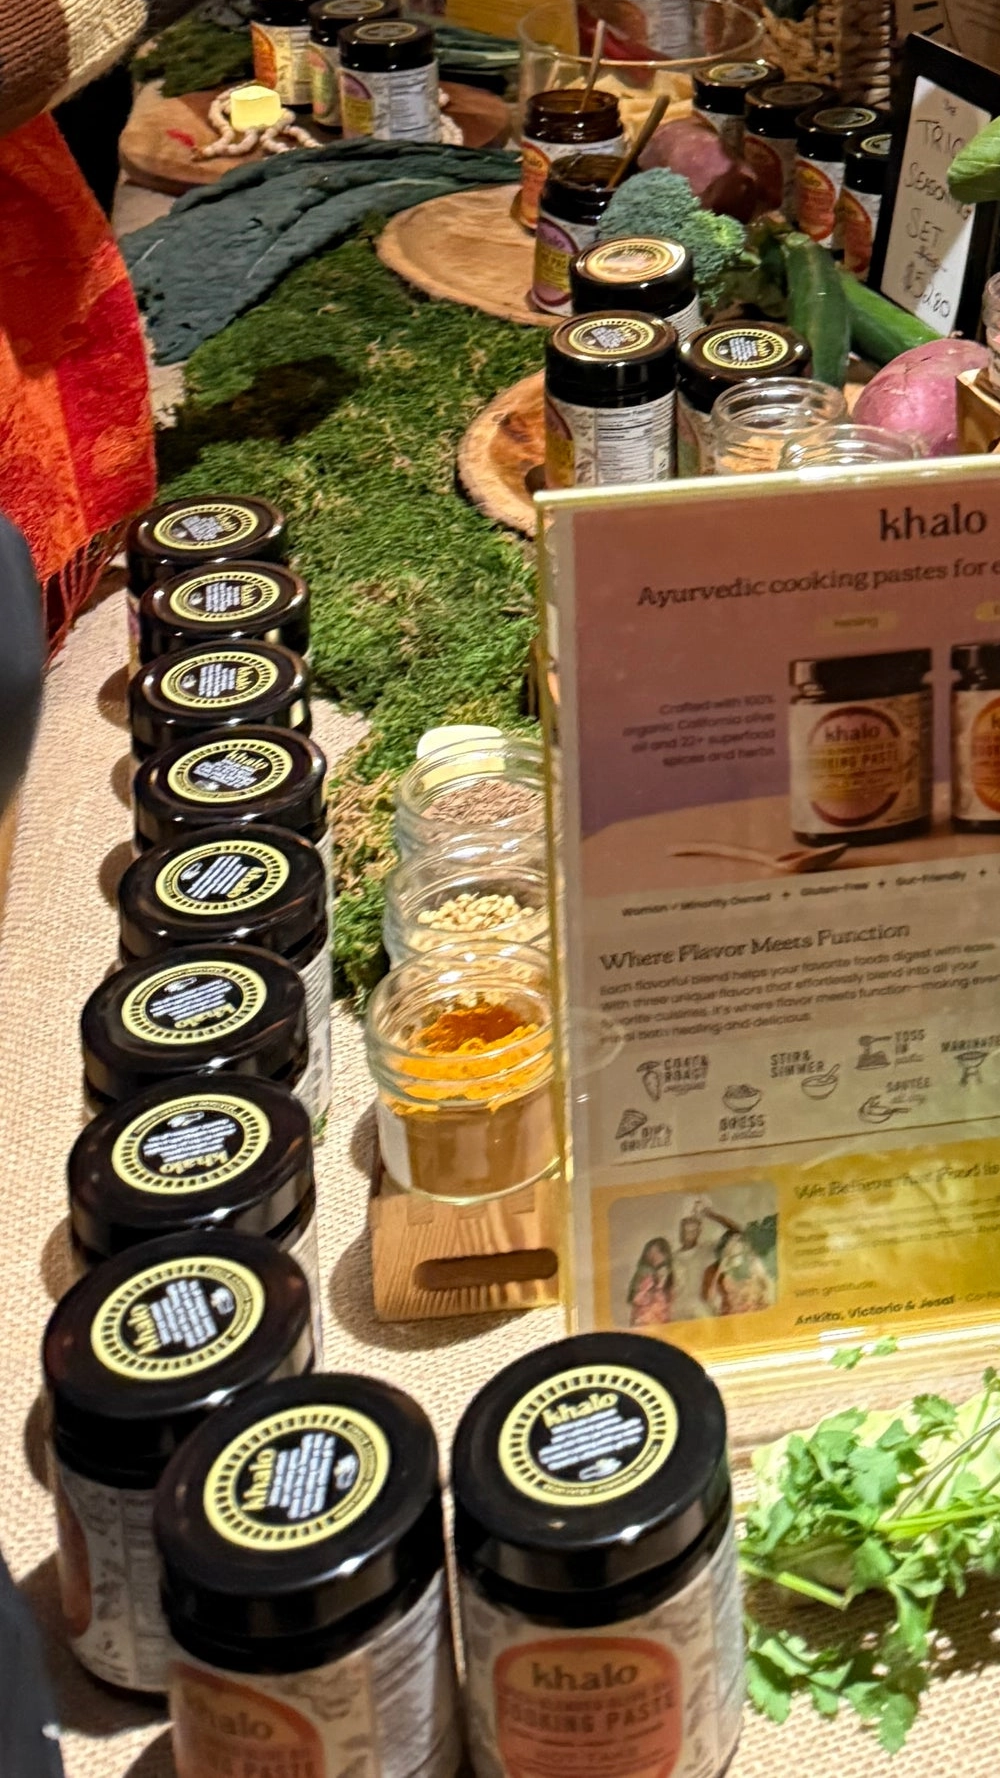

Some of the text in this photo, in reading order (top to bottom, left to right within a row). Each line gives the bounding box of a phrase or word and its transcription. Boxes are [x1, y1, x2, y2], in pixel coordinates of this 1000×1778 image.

[907, 207, 944, 248] SET
[879, 502, 988, 542] khalo
[637, 576, 766, 609] Ayurvedic
[769, 568, 870, 595] cooking
[872, 562, 948, 591] pastes
[952, 557, 987, 579] for
[660, 700, 710, 716] Crafted
[824, 722, 882, 744] khalo
[600, 923, 911, 971] Where Flavor Meets Function
[894, 1029, 926, 1043] TOSS
[769, 1059, 828, 1079] SIMMER
[158, 1150, 230, 1175] khalo
[847, 1302, 902, 1320] Victoria
[903, 1300, 916, 1311] &
[126, 1302, 163, 1356] khalo
[540, 1392, 620, 1429] khalo
[240, 1447, 278, 1512] khalo
[531, 1662, 639, 1692] khalo
[605, 1688, 675, 1733] PASTE
